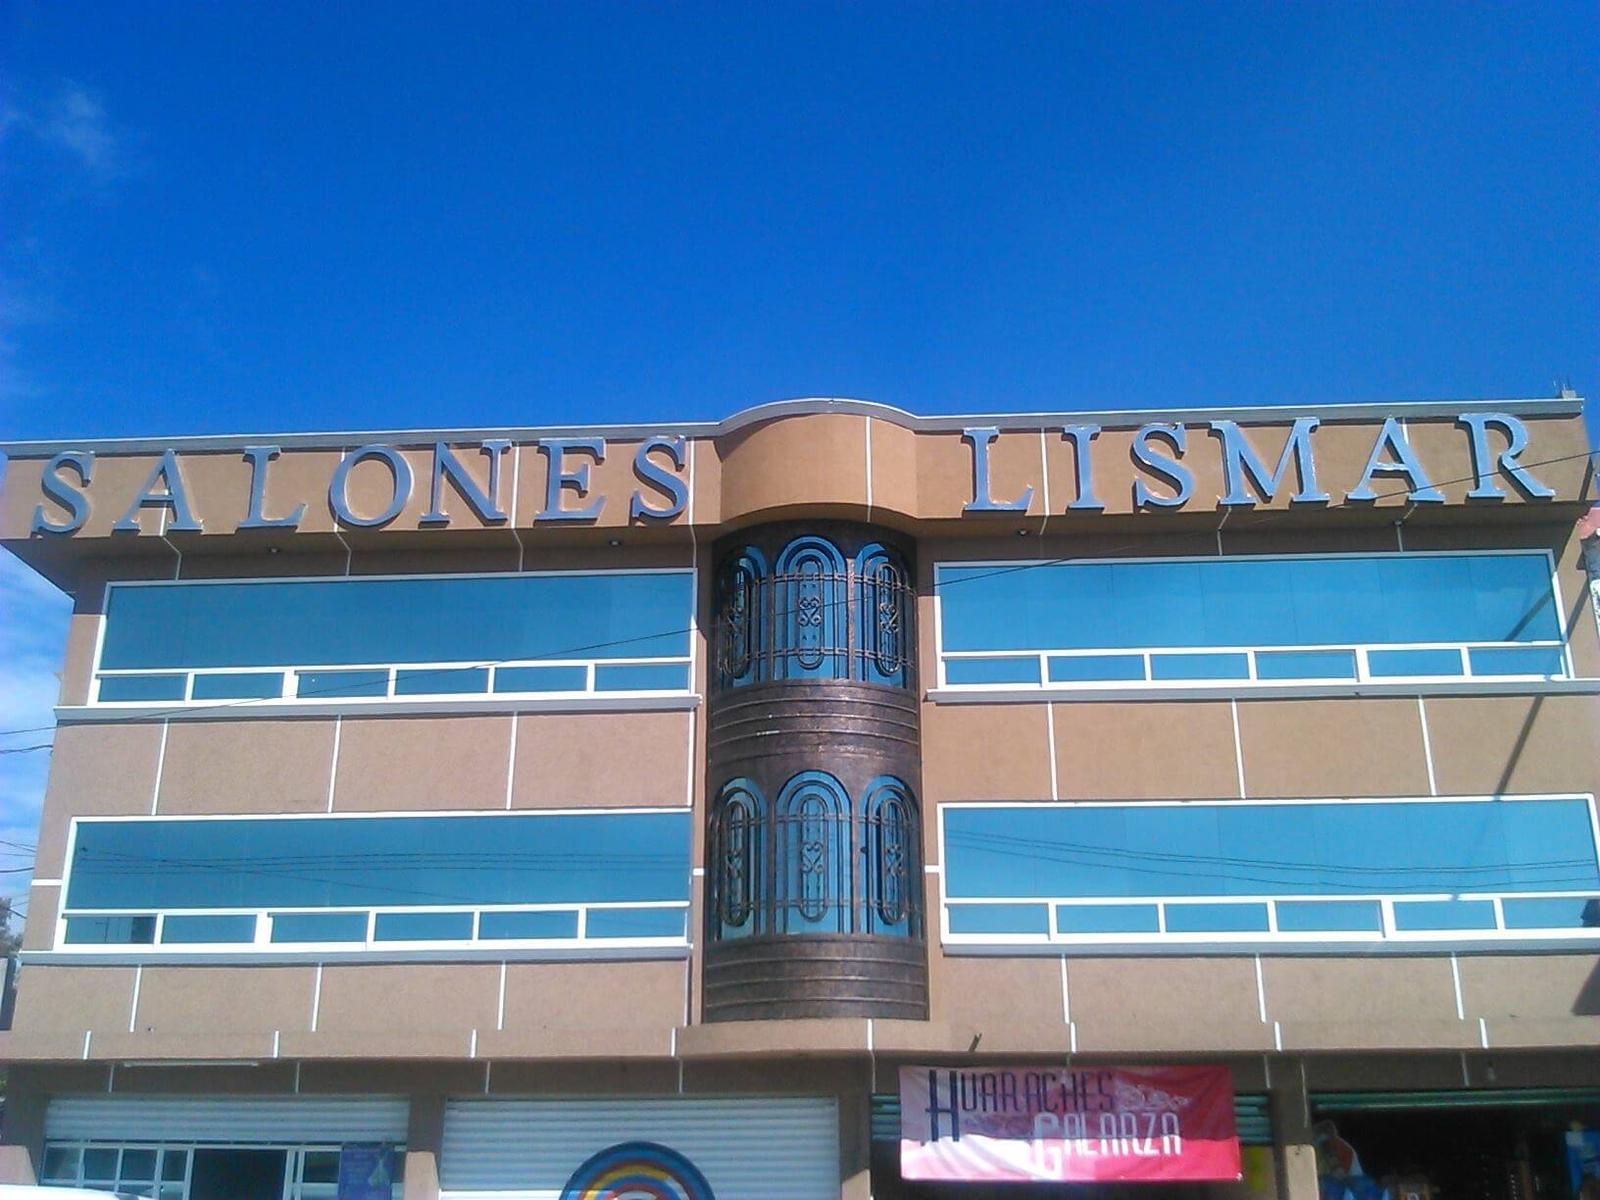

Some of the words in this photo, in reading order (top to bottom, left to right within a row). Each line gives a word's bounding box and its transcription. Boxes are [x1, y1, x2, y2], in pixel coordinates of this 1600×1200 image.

[33, 436, 690, 536] SALONES
[962, 411, 1556, 516] LISMAR
[926, 1069, 1114, 1142] HUARACHES
[1034, 1111, 1182, 1179] GALARZA
